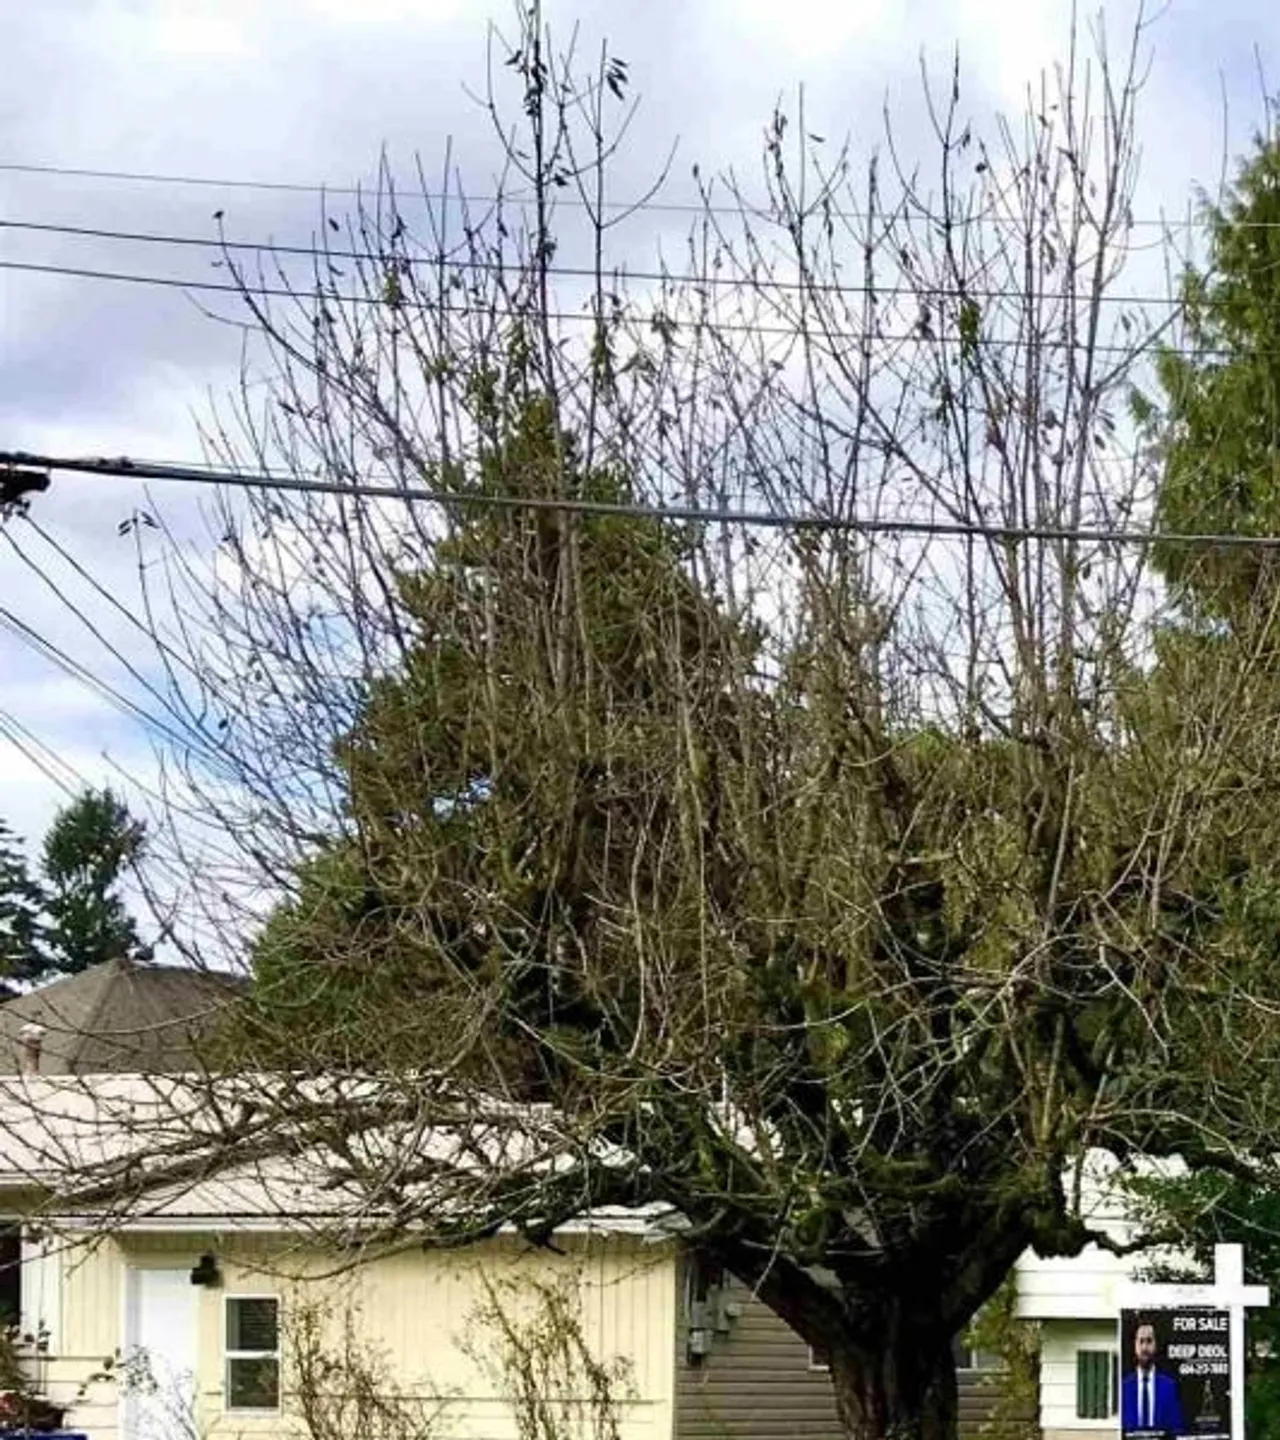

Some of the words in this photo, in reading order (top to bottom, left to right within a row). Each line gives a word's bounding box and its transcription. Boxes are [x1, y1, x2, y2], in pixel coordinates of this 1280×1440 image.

[1173, 1317, 1196, 1331] FOR
[1198, 1317, 1228, 1331] SALE
[1168, 1344, 1196, 1359] DEEP
